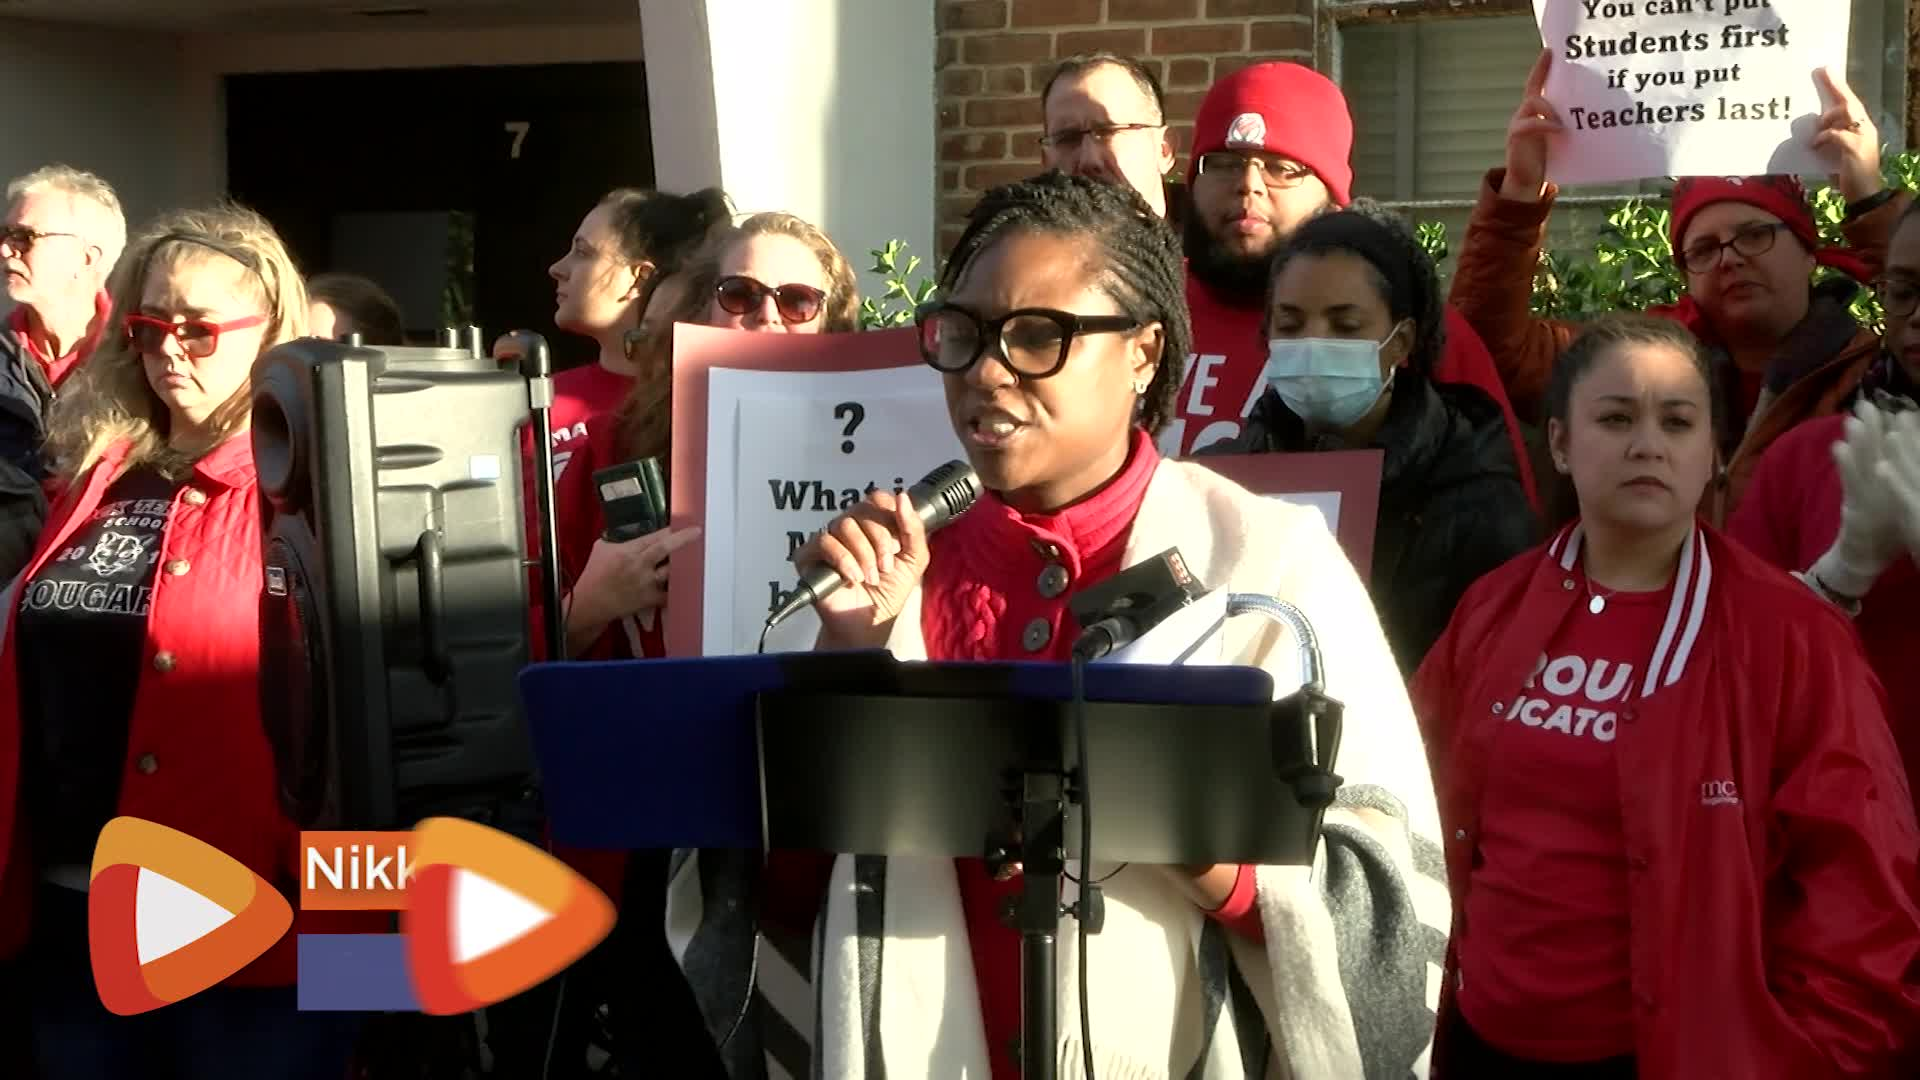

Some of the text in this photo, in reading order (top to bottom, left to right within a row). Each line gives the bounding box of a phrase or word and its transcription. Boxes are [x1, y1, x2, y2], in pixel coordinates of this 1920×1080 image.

[1584, 0, 1635, 19] You
[1565, 23, 1790, 60] Students first
[1607, 63, 1741, 93] if you put
[1569, 96, 1791, 131] Teachers last!
[504, 121, 530, 159] 7
[833, 402, 865, 454] ?
